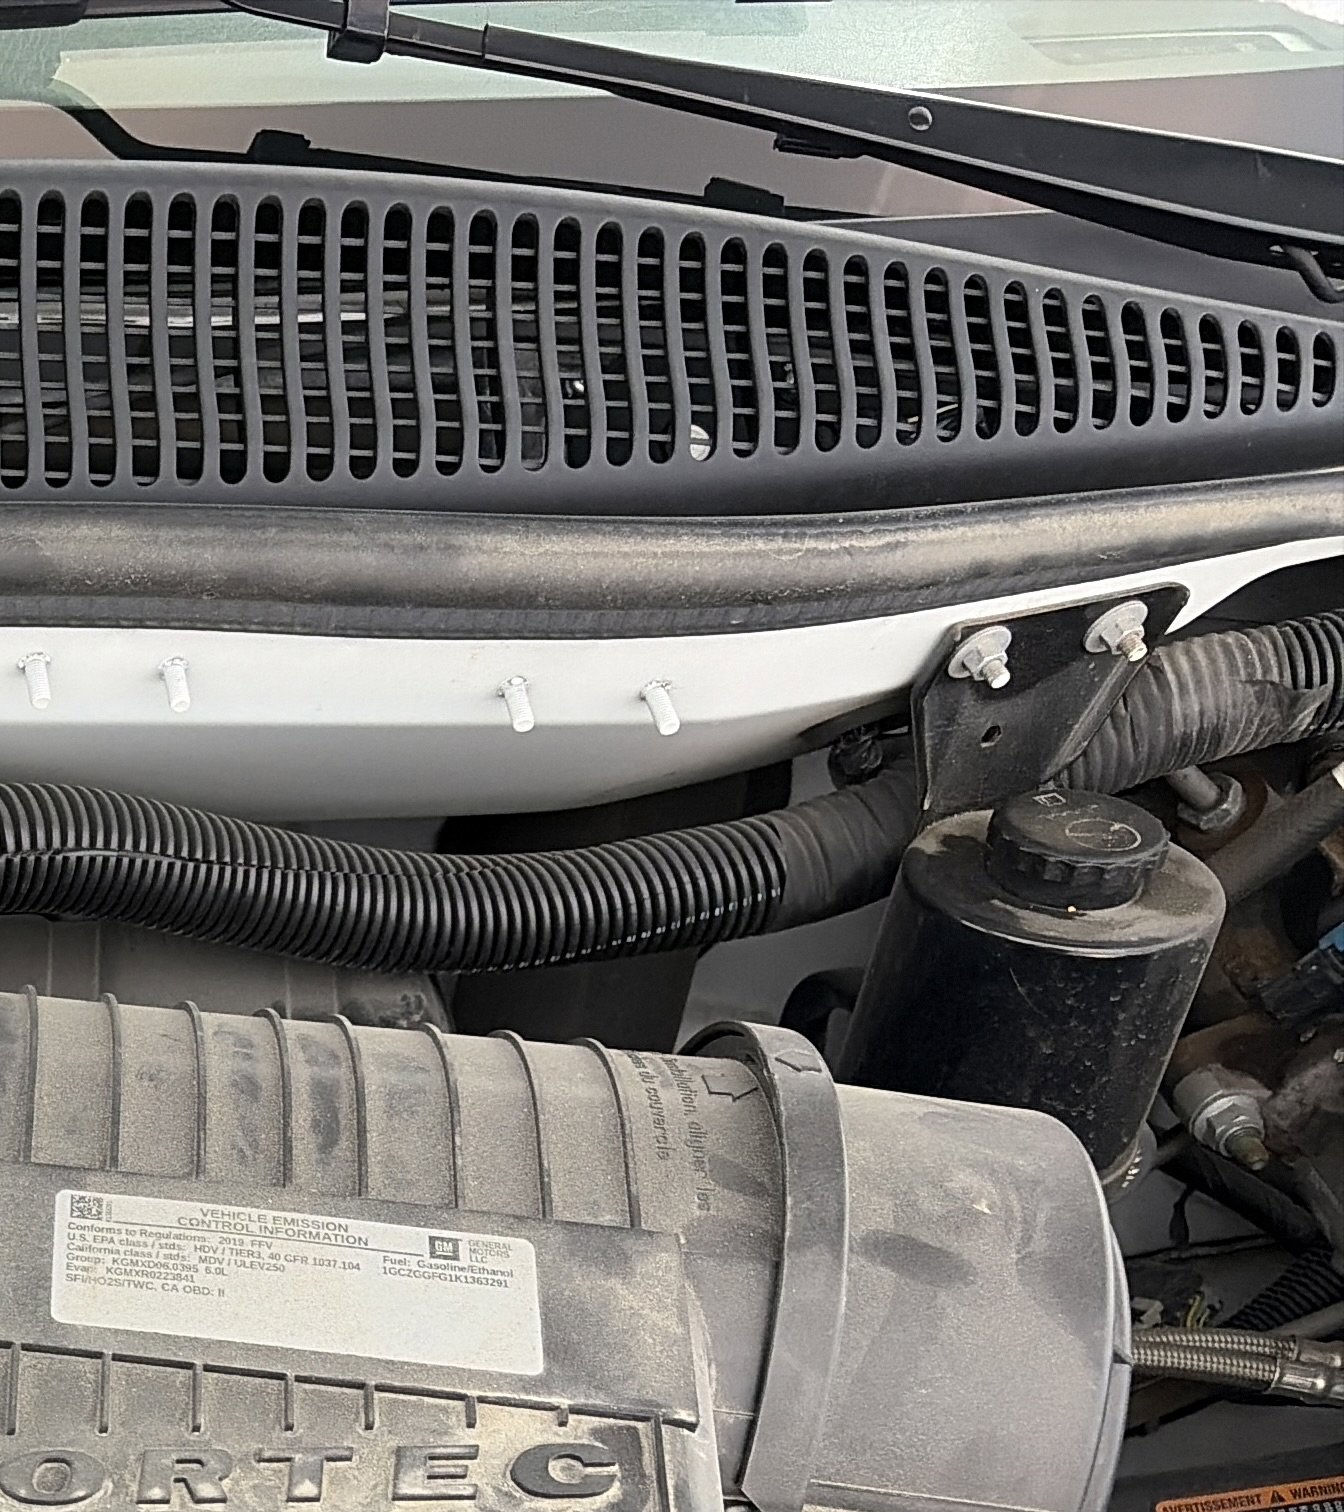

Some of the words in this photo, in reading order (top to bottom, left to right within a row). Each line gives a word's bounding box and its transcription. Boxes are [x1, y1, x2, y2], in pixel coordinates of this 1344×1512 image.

[177, 1216, 257, 1235] CONTROL
[259, 1226, 369, 1247] INFORMATION
[200, 1207, 268, 1224] VEHICLE
[272, 1216, 349, 1234] EMISSION
[67, 1222, 123, 1236] Conforms
[125, 1228, 137, 1237] to
[139, 1229, 212, 1244] Regulations:
[218, 1235, 245, 1248] 2019
[250, 1239, 274, 1251] FFV
[434, 1239, 454, 1254] GM
[468, 1239, 513, 1251] GENERAL
[66, 1242, 120, 1257] California
[123, 1247, 153, 1259] class
[198, 1254, 226, 1267] MDV
[236, 1258, 286, 1273] ULEV250
[67, 1232, 89, 1243] U.S.
[92, 1234, 116, 1246] EPA
[119, 1237, 149, 1249] class
[193, 1243, 219, 1255] HDV
[268, 1250, 282, 1261] 40
[284, 1253, 309, 1266] CFR
[312, 1258, 361, 1272] 1037.104
[469, 1247, 510, 1259] MOTORS
[469, 1255, 489, 1264] LLC
[66, 1252, 105, 1266] Group:
[204, 1265, 230, 1277] 6.0L
[105, 1266, 196, 1284] KGMXR0223841
[382, 1255, 411, 1267] Fuel:
[417, 1259, 514, 1279] Gasoline/Ethanol
[161, 1283, 180, 1294] CA
[183, 1285, 214, 1297] OBD:
